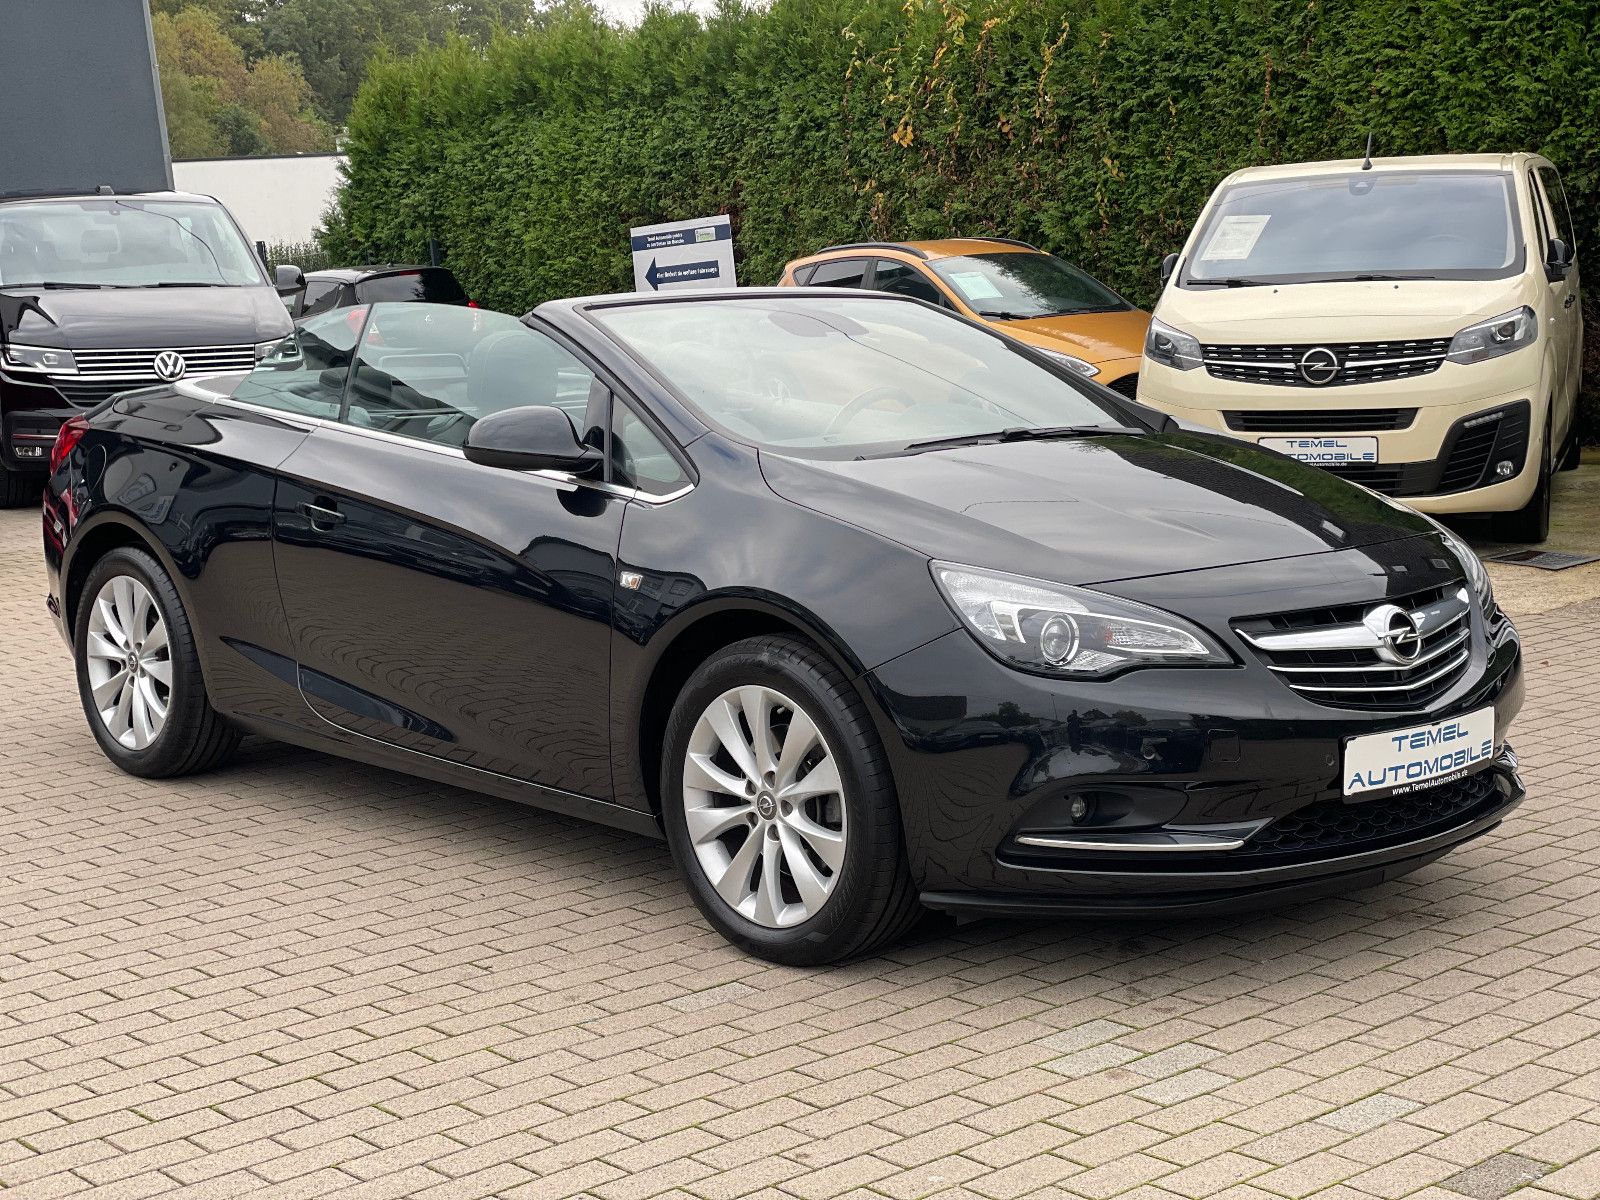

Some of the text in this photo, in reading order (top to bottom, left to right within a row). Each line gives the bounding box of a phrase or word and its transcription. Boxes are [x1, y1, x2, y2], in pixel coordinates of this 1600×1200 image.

[1286, 440, 1347, 448] TEMEL
[1391, 722, 1469, 752] TEMEL
[1348, 738, 1493, 790] AUTOMOBILE
[1392, 769, 1469, 796] www.TemelAutomobile.de
